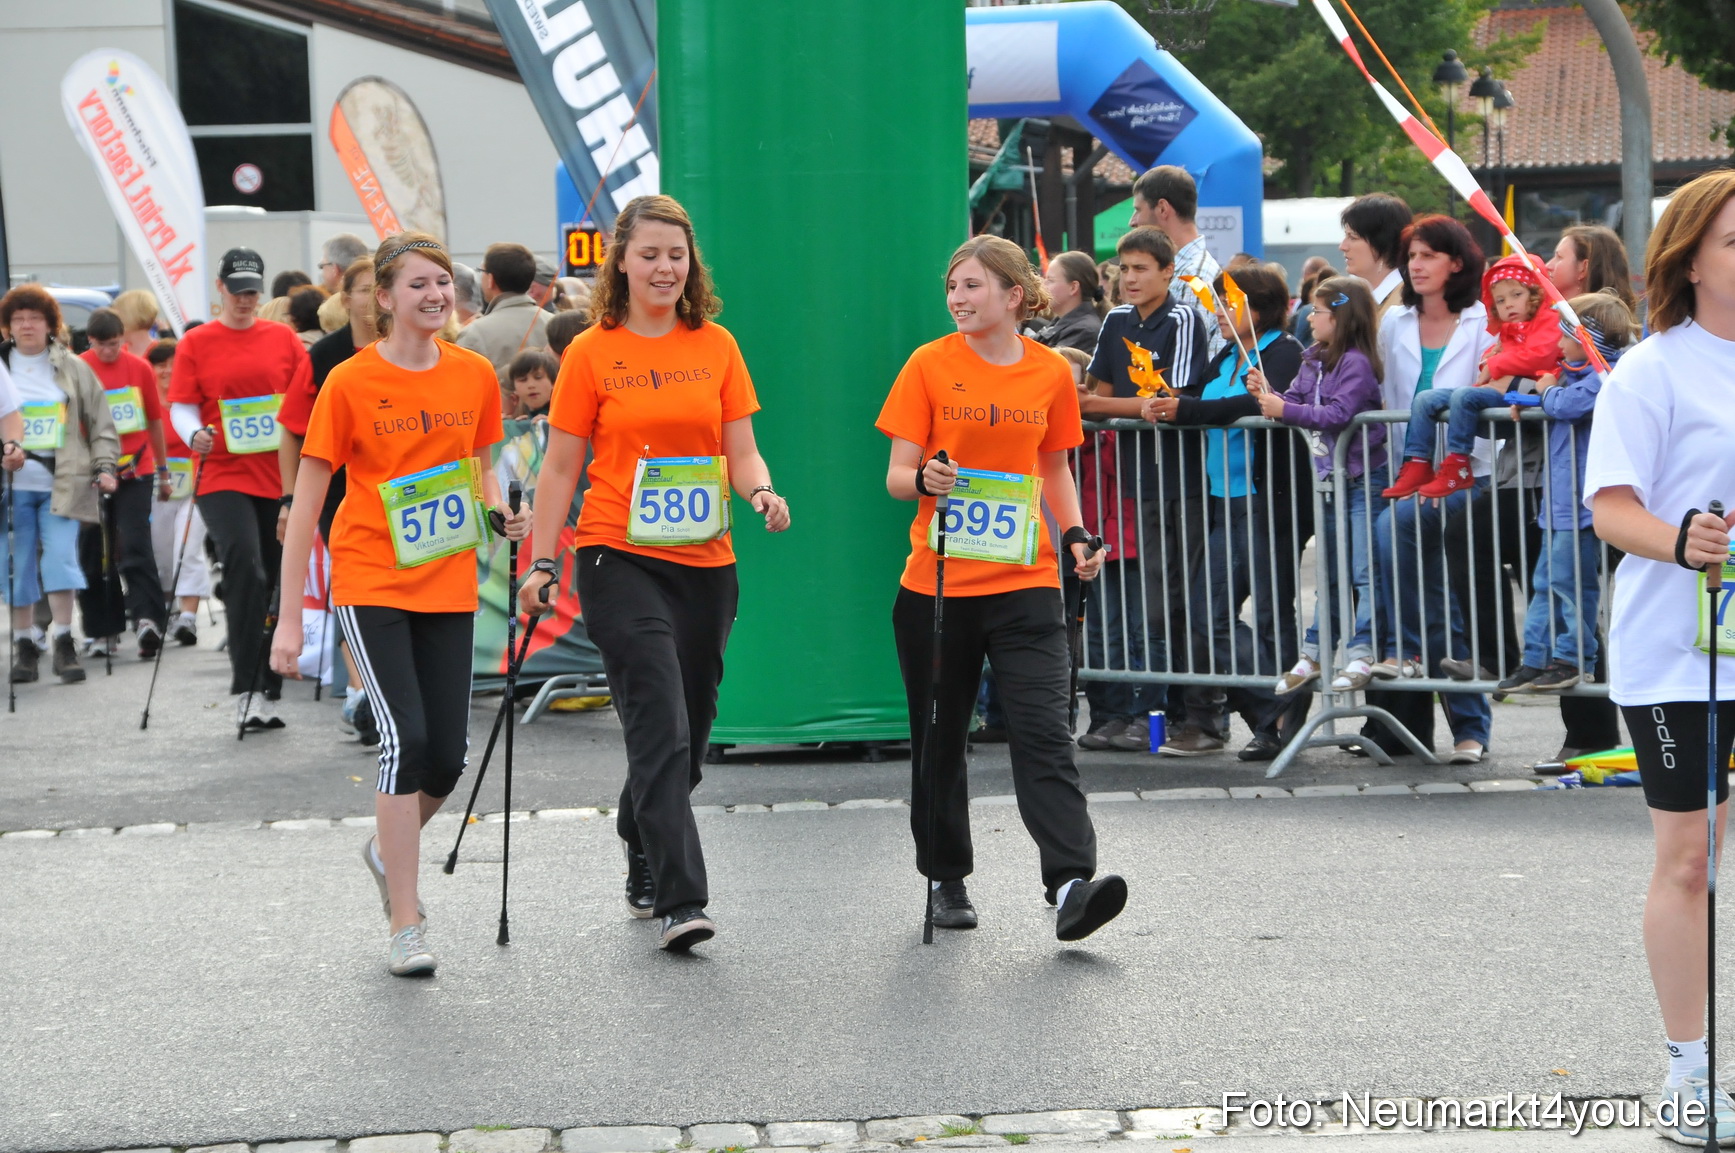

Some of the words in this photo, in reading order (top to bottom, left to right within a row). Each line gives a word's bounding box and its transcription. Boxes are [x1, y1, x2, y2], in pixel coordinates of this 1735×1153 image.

[603, 374, 649, 392] EURO
[663, 367, 712, 384] POLES
[112, 403, 134, 421] 69
[373, 416, 419, 436] EURO
[434, 410, 475, 428] POLES
[943, 406, 987, 421] EURO
[1003, 408, 1045, 425] POLES
[228, 415, 275, 439] 659
[639, 487, 711, 524] 580
[401, 493, 466, 544] 579
[661, 524, 675, 533] Pia
[945, 498, 1017, 540] 595
[413, 535, 445, 551] Viktoria
[1652, 706, 1677, 770] odlo
